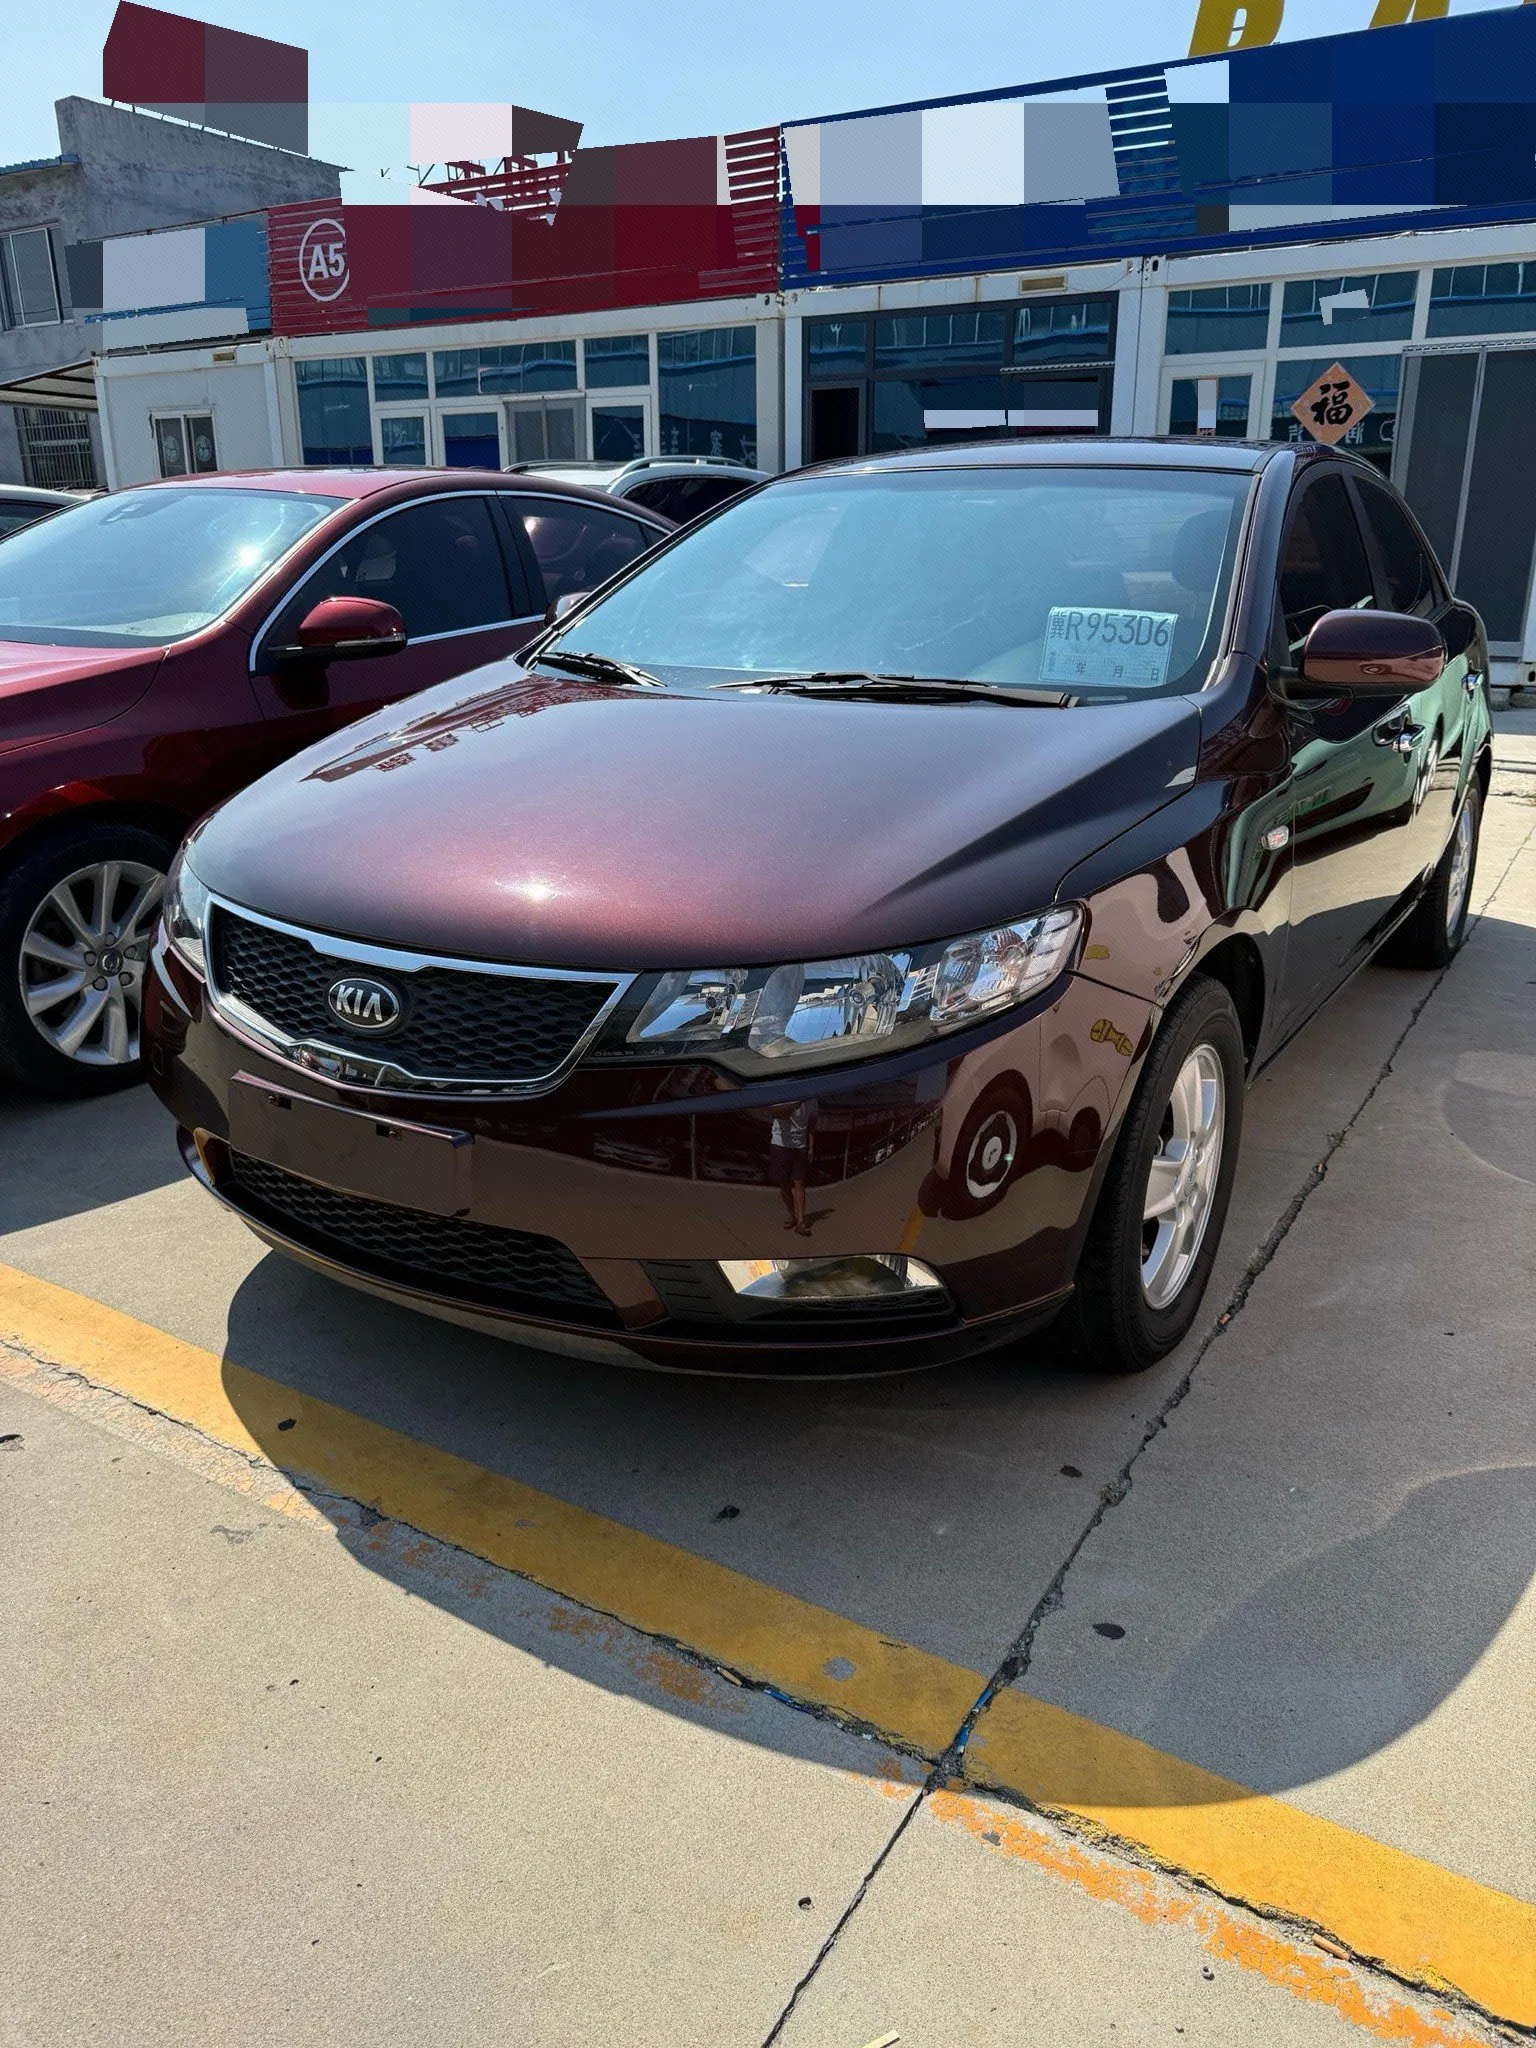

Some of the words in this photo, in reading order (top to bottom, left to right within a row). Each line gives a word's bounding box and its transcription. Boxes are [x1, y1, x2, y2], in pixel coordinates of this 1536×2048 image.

[308, 242, 346, 280] A5
[1311, 381, 1353, 425] 福
[1050, 611, 1169, 647] 冀R953D6
[1112, 665, 1124, 679] 月
[1150, 668, 1160, 681] 日
[336, 984, 383, 1022] KIA
